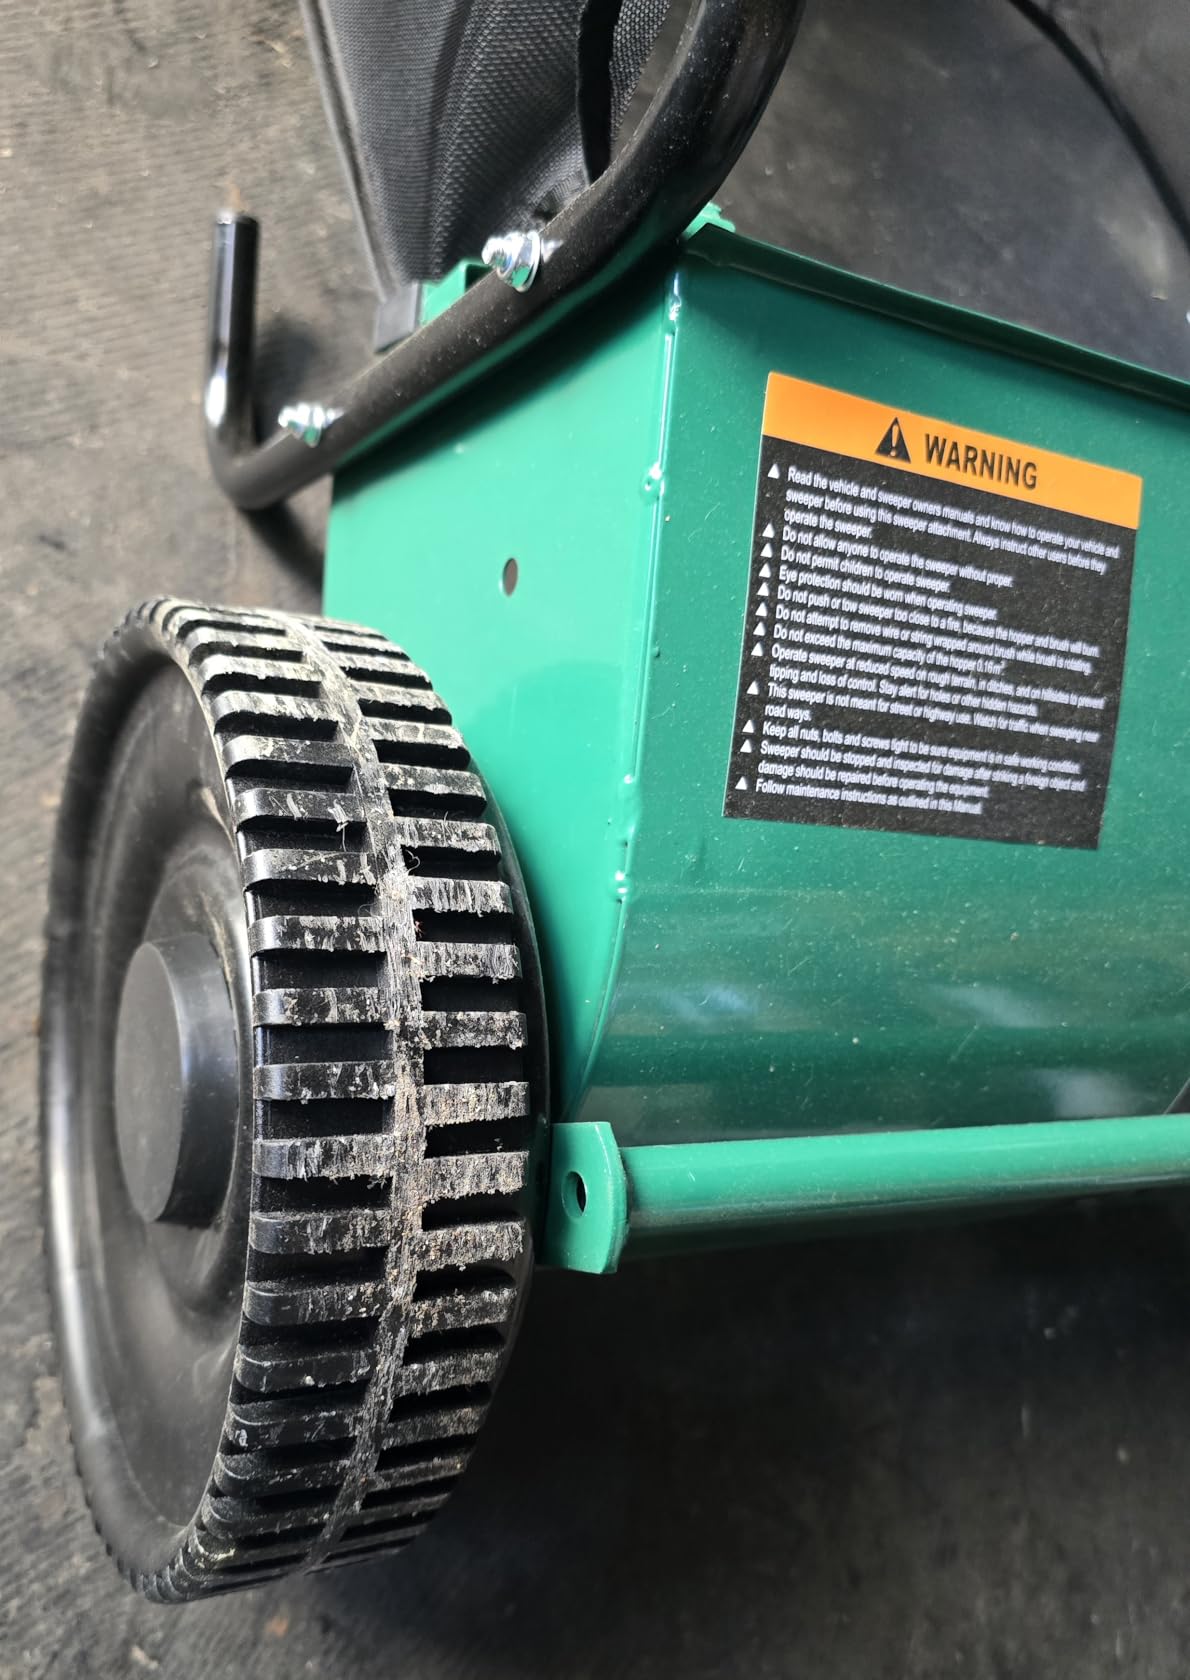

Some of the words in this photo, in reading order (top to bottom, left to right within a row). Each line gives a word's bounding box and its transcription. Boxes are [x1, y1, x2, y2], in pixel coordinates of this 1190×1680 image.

[926, 435, 1035, 488] WARNING
[784, 508, 818, 526] operate
[819, 514, 834, 530] the
[834, 520, 872, 538] sweeper.
[786, 489, 823, 508] sweeper
[824, 495, 852, 514] before
[853, 504, 876, 523] using
[877, 508, 892, 523] this
[893, 514, 927, 532] sweeper
[972, 530, 1000, 550] Always
[1000, 537, 1027, 554] instruct
[1027, 544, 1047, 558] other
[1047, 550, 1067, 563] users
[1067, 552, 1090, 569] before
[787, 466, 812, 485] Read
[813, 473, 827, 489] the
[829, 479, 859, 496] vehicle
[860, 486, 877, 500] and
[877, 491, 912, 509] sweeper
[912, 500, 941, 516] owners
[942, 506, 974, 524] manuals
[975, 515, 990, 527] and
[990, 516, 1011, 532] know
[1011, 521, 1027, 536] how
[1028, 526, 1036, 538] to
[1036, 530, 1064, 545] operate
[1064, 537, 1080, 549] your
[1080, 540, 1105, 555] vehicle
[1105, 546, 1119, 558] and
[780, 545, 795, 561] Do
[795, 551, 811, 565] not
[811, 554, 839, 570] permit
[839, 559, 873, 576] children
[874, 565, 883, 579] to
[884, 569, 915, 585] operate
[915, 576, 949, 593] sweeper.
[782, 525, 797, 542] Do
[797, 531, 813, 545] not
[813, 533, 836, 550] allow
[837, 540, 869, 557] anyone
[869, 545, 879, 559] to
[879, 549, 910, 565] operate
[910, 554, 924, 568] the
[925, 559, 958, 576] sweeper
[959, 566, 986, 581] without
[777, 584, 791, 600] Do
[792, 590, 808, 603] not
[807, 593, 829, 607] push
[830, 597, 841, 609] or
[841, 597, 858, 612] tow
[858, 602, 894, 620] sweeper
[894, 607, 908, 621] too
[908, 610, 930, 626] close
[930, 614, 939, 627] to
[939, 618, 946, 629] a
[962, 620, 995, 638] because
[995, 626, 1008, 640] the
[779, 564, 797, 584] Eye
[798, 572, 840, 589] protection
[841, 579, 871, 595] should
[870, 583, 882, 598] be
[883, 589, 904, 602] worn
[904, 591, 926, 606] when
[927, 597, 963, 616] operating
[773, 623, 787, 639] Do
[788, 629, 804, 642] not
[804, 632, 836, 647] exceed
[836, 635, 851, 650] the
[852, 640, 892, 656] maximum
[892, 647, 925, 665] capacity
[926, 650, 936, 663] of
[935, 652, 949, 666] the
[949, 655, 976, 672] hopper
[775, 604, 790, 620] Do
[790, 609, 806, 623] not
[806, 611, 839, 630] attempt
[839, 616, 849, 630] to
[849, 620, 881, 635] remove
[882, 625, 899, 639] wire
[900, 629, 910, 640] or
[910, 630, 933, 648] string
[933, 636, 967, 651] wrapped
[966, 641, 994, 656] around
[994, 644, 1015, 659] brush
[769, 663, 799, 683] tipping
[799, 670, 818, 683] and
[818, 670, 836, 686] loss
[836, 674, 847, 687] of
[847, 677, 876, 691] control.
[879, 679, 898, 698] Stay
[898, 684, 917, 698] alert
[917, 685, 929, 699] for
[929, 688, 951, 703] holes
[951, 694, 961, 704] or
[960, 694, 981, 707] other
[771, 643, 807, 662] Operate
[808, 652, 845, 669] sweeper
[845, 657, 856, 669] at
[855, 659, 890, 675] reduced
[890, 665, 915, 679] speed
[915, 669, 927, 680] on
[927, 671, 950, 687] rough
[977, 679, 986, 690] in
[764, 704, 786, 717] road
[787, 708, 811, 722] ways.
[768, 682, 787, 698] This
[788, 688, 825, 704] sweeper
[825, 691, 834, 705] is
[834, 694, 850, 707] not
[849, 697, 877, 710] meant
[877, 698, 889, 712] for
[889, 701, 913, 716] street
[912, 706, 923, 717] or
[923, 706, 955, 724] highway
[760, 740, 800, 759] Sweeper
[800, 746, 830, 761] should
[829, 749, 842, 762] be
[842, 751, 876, 767] stopped
[876, 756, 893, 768] and
[762, 721, 786, 739] Keep
[787, 725, 799, 739] all
[799, 728, 820, 742] nuts,
[822, 729, 843, 744] bolts
[843, 733, 861, 746] and
[861, 736, 890, 749] screws
[890, 738, 909, 754] tight
[909, 741, 918, 753] to
[918, 741, 929, 755] be
[929, 745, 947, 757] sure
[755, 778, 785, 794] Follow
[786, 783, 840, 799] maintenance
[841, 788, 886, 804] instructions
[886, 794, 898, 805] as
[758, 760, 794, 778] damage
[795, 764, 824, 779] should
[824, 767, 836, 781] be
[837, 771, 871, 784] repaired
[872, 772, 898, 787] before
